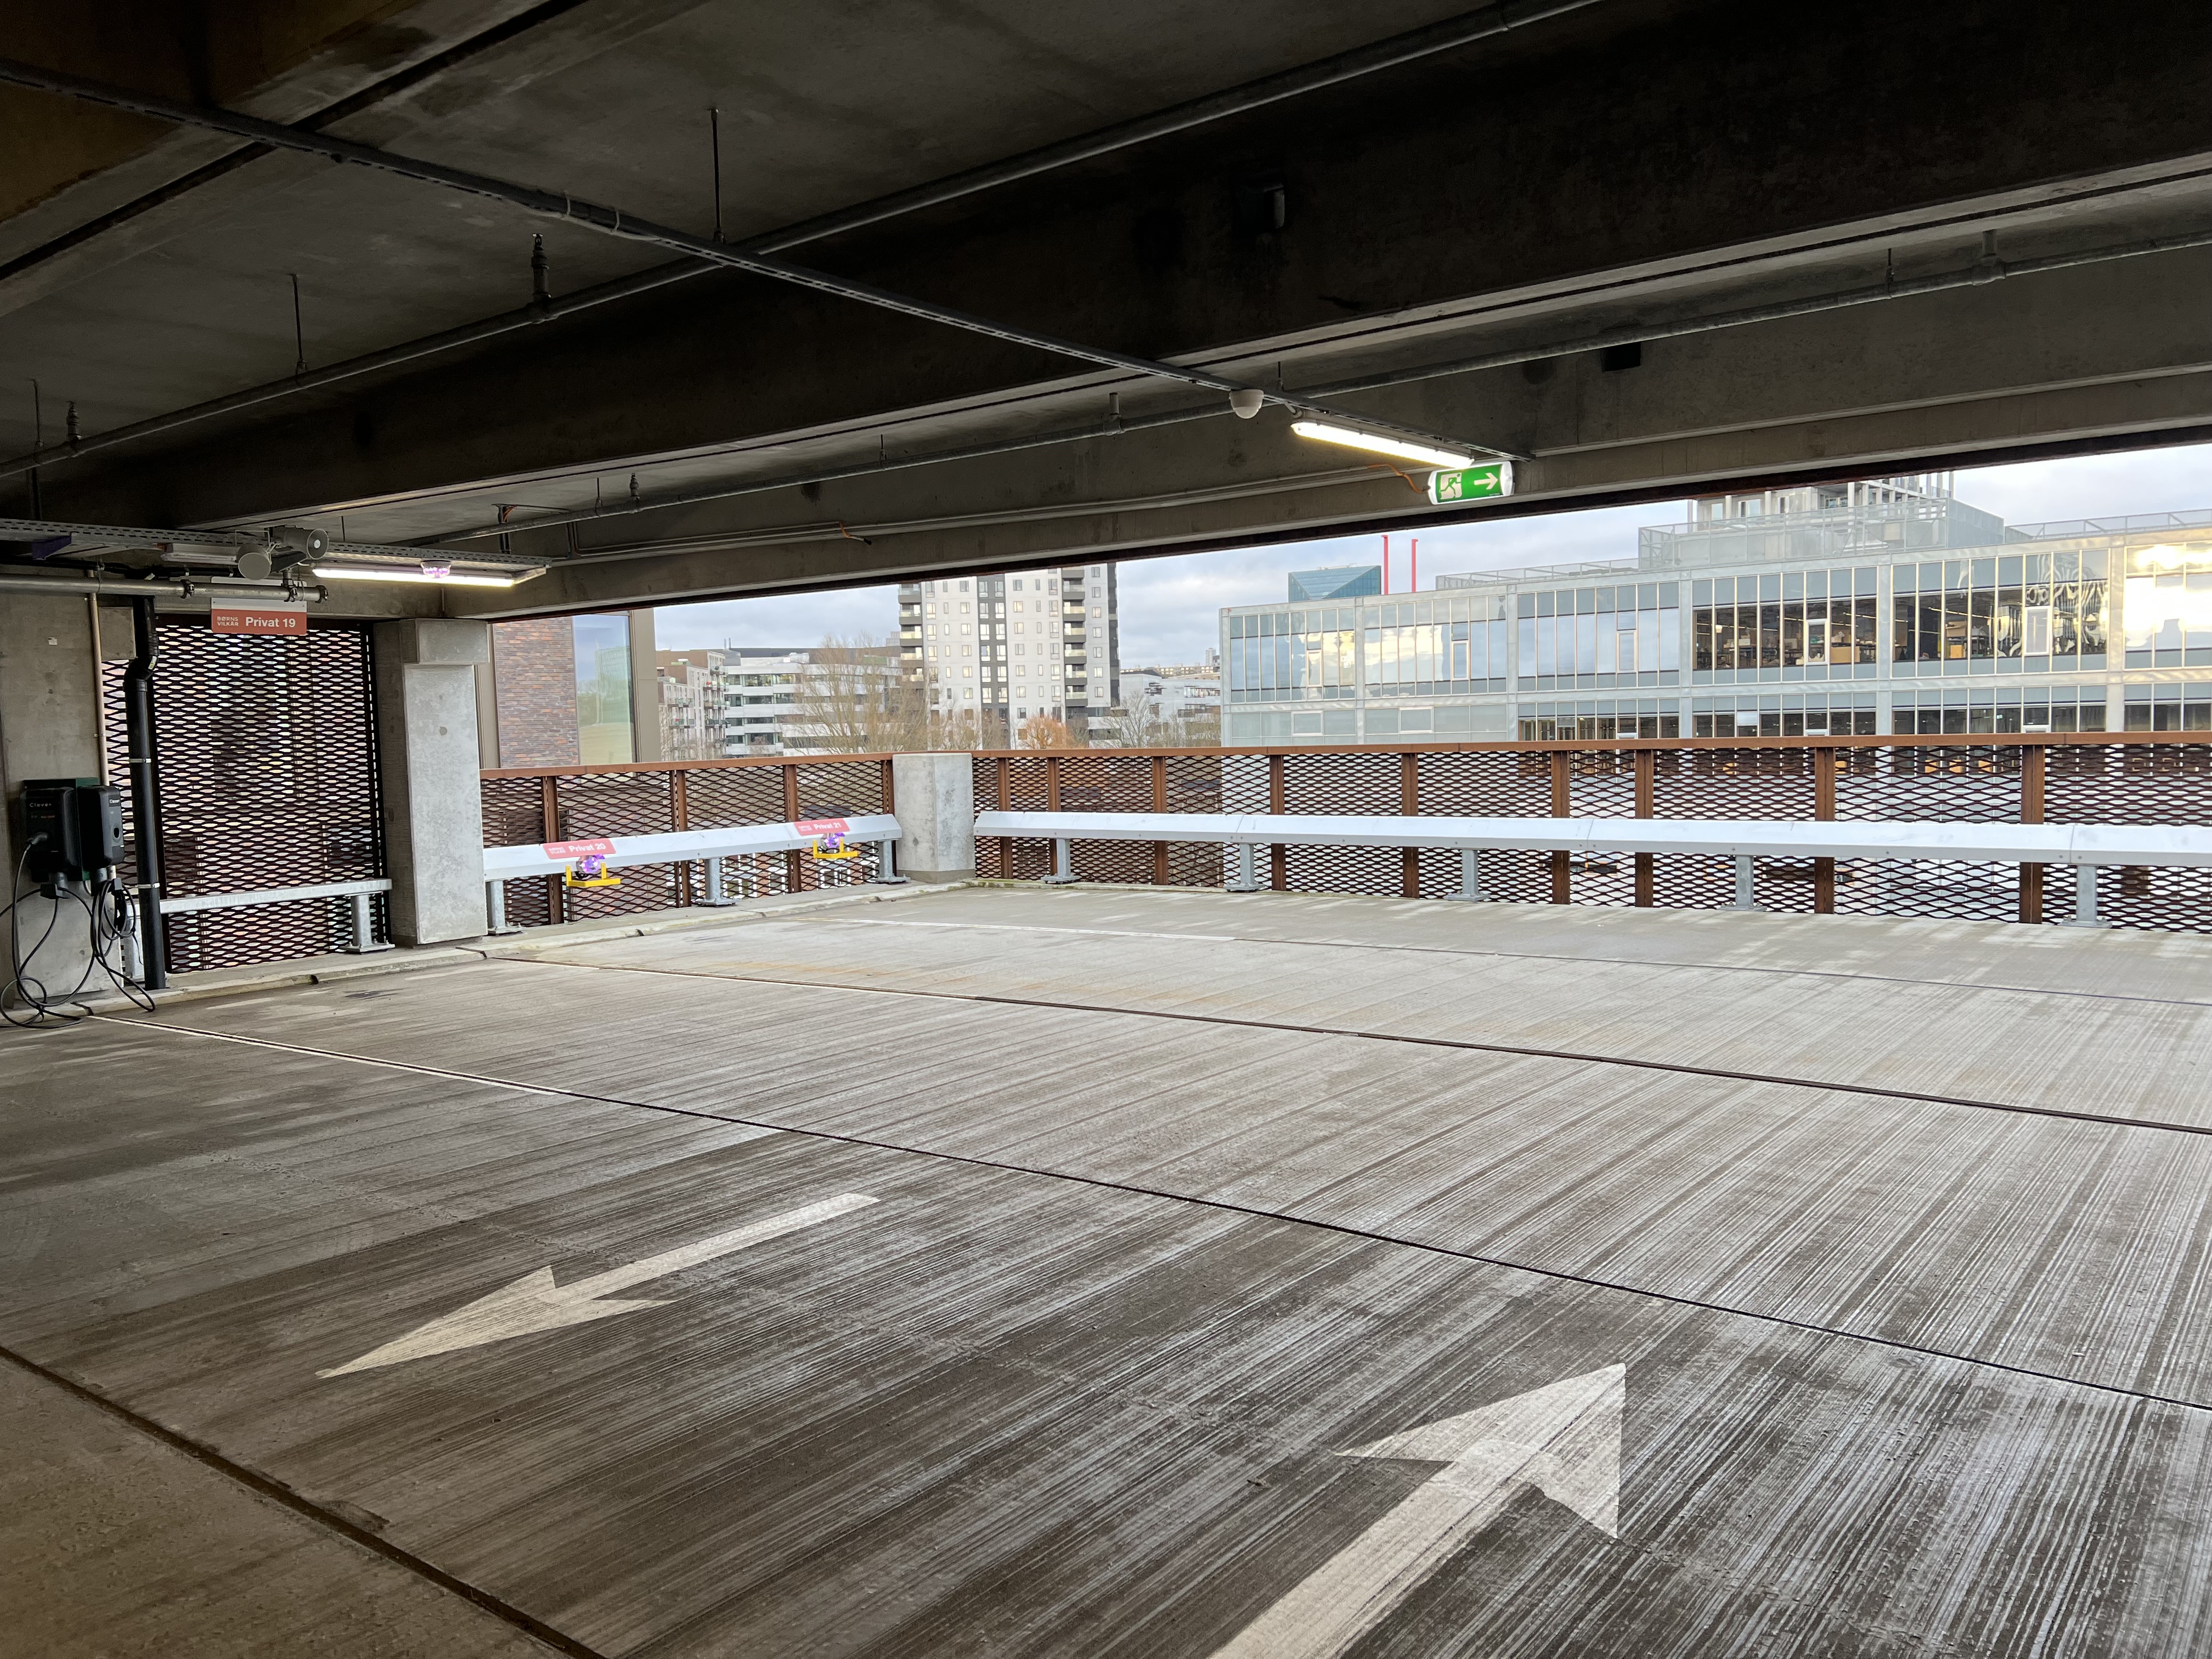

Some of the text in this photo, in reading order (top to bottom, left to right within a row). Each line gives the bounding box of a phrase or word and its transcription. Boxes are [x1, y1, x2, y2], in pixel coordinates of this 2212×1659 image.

[245, 617, 296, 628] Privat 19
[568, 844, 594, 853] Privat
